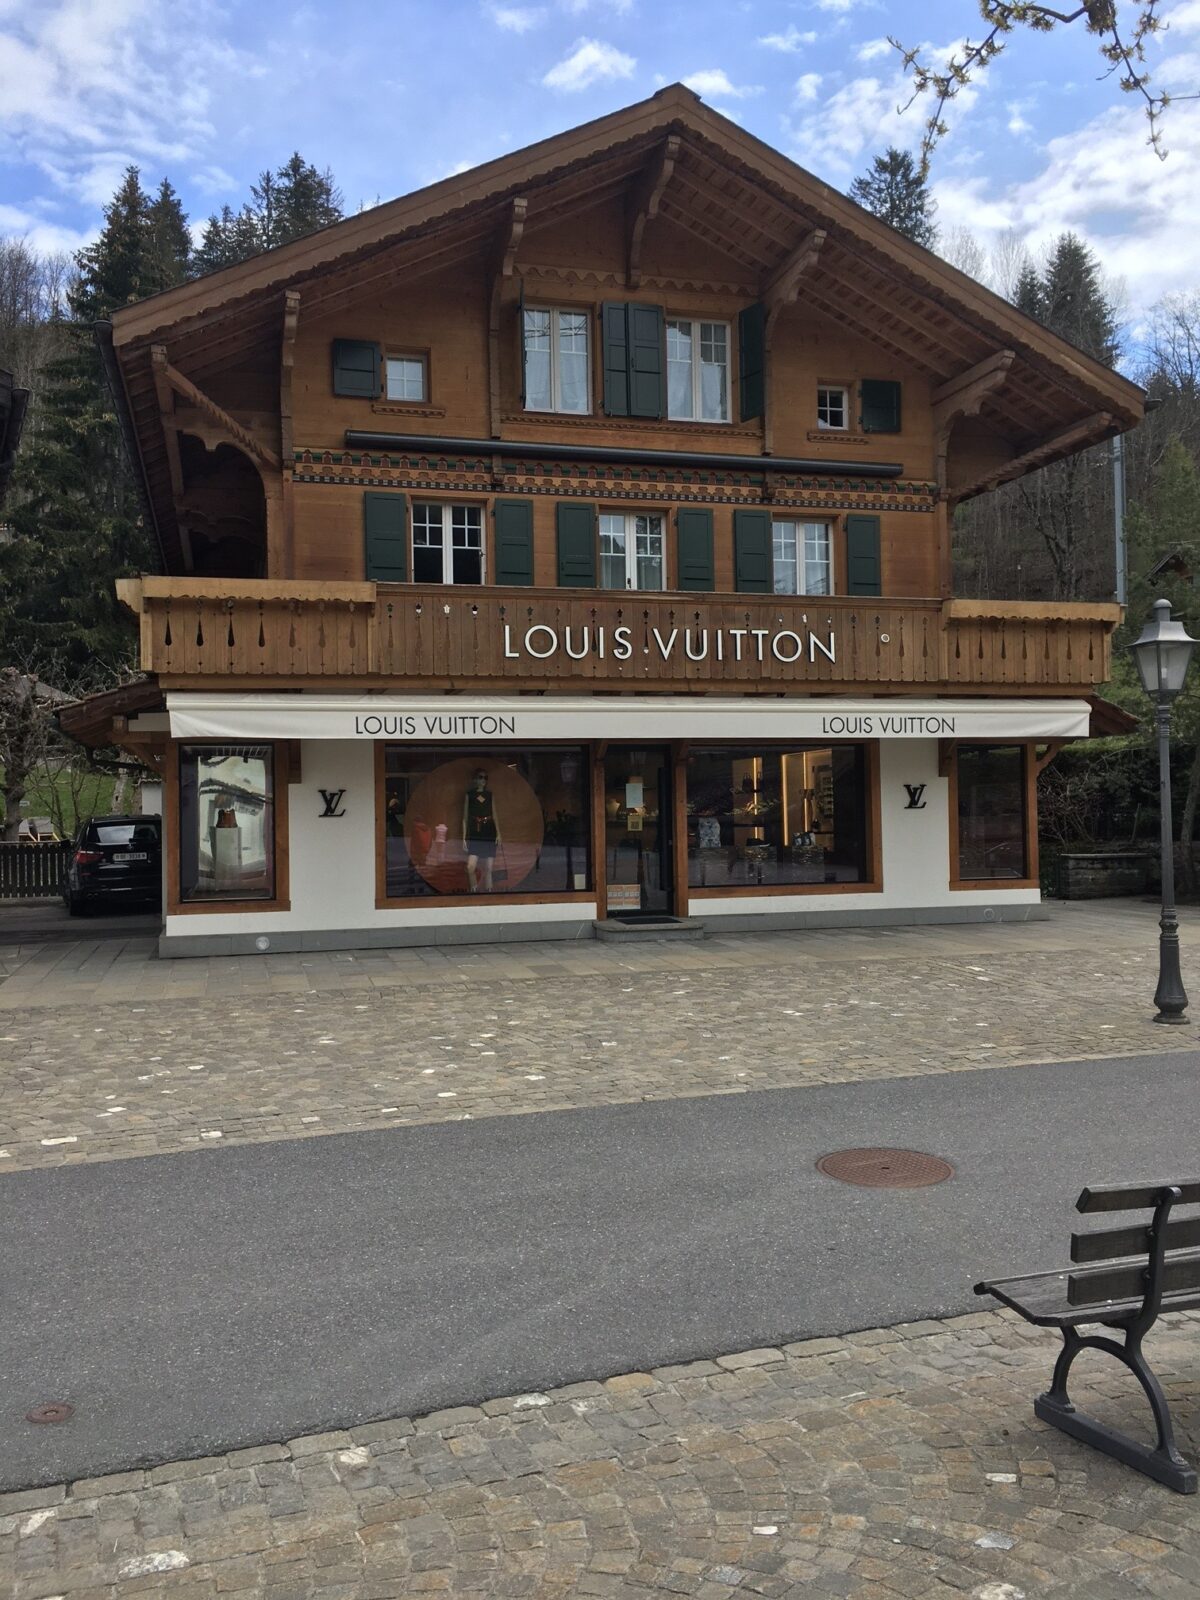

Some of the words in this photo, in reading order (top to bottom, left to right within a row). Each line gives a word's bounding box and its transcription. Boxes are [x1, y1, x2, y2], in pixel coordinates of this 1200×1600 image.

[504, 624, 633, 660] LOUIS
[652, 628, 837, 664] VUITTON
[355, 716, 416, 735] LOUIS
[423, 716, 515, 735] VUITTON
[822, 716, 873, 734] LOUIS
[878, 716, 955, 734] VUITTON
